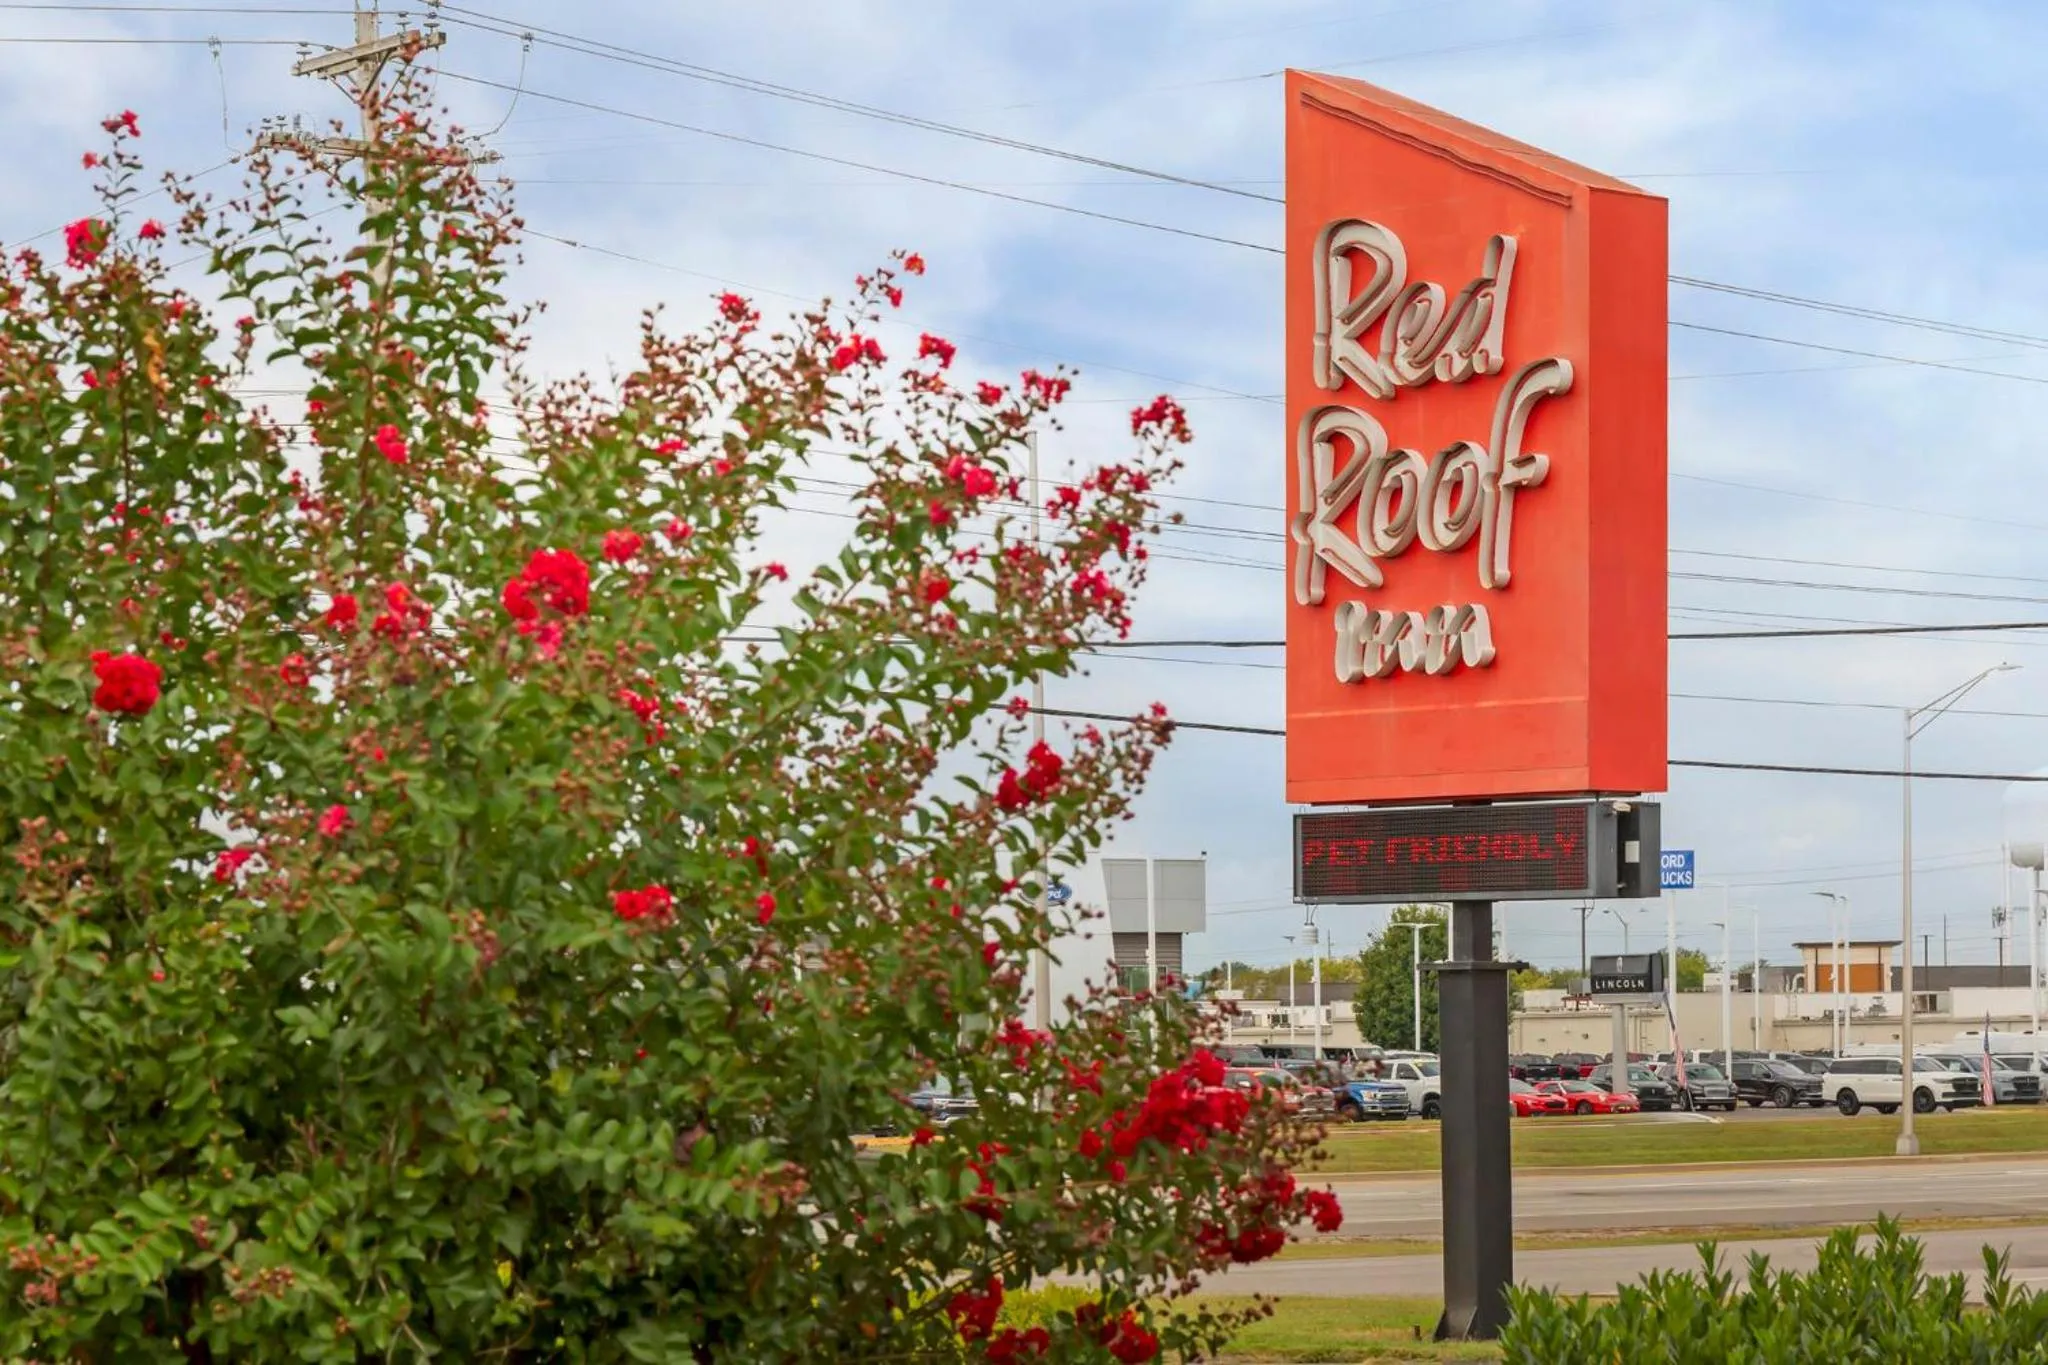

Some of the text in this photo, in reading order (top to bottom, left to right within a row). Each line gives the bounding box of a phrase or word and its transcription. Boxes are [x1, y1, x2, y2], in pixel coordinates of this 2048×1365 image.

[1313, 217, 1518, 400] Red
[1292, 357, 1574, 605] Roof
[1303, 831, 1578, 866] PET FRIENDLY
[1595, 979, 1645, 990] LINCOLN
